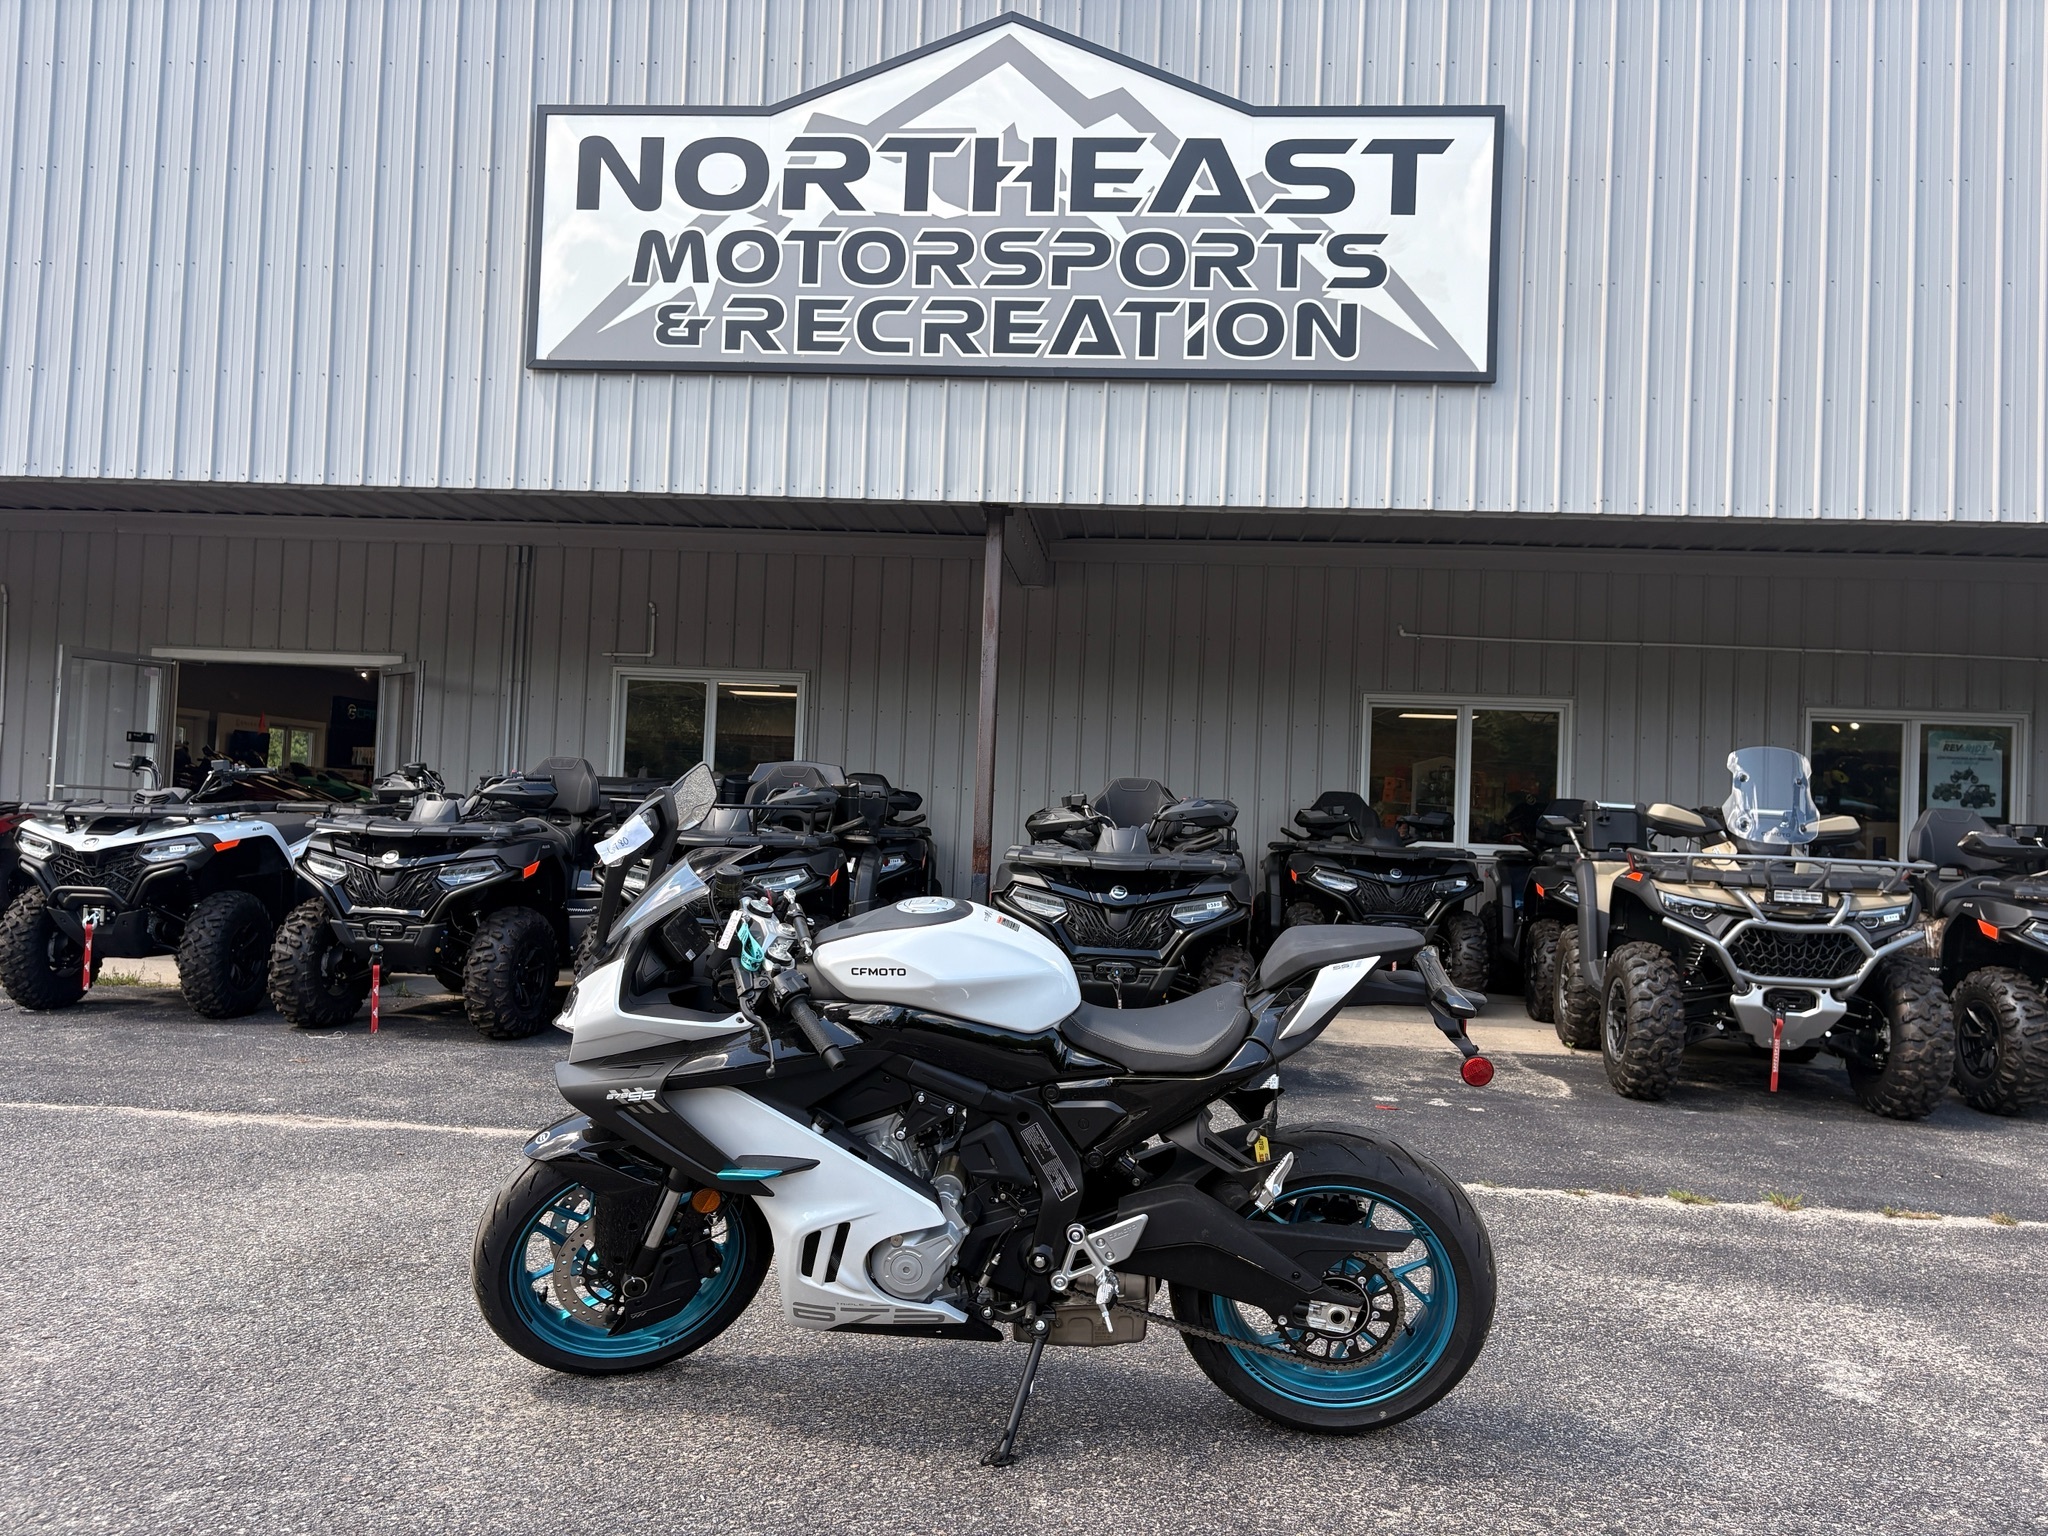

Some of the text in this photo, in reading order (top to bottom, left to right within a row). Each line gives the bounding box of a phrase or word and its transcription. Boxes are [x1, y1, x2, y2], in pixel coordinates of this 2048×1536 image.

[576, 136, 1456, 216] NORTHEAST
[632, 229, 1389, 290] MOTORSPORTS
[655, 297, 1359, 359] & RECREATION
[851, 967, 906, 976] CFMOTO
[792, 1301, 945, 1324] 675
